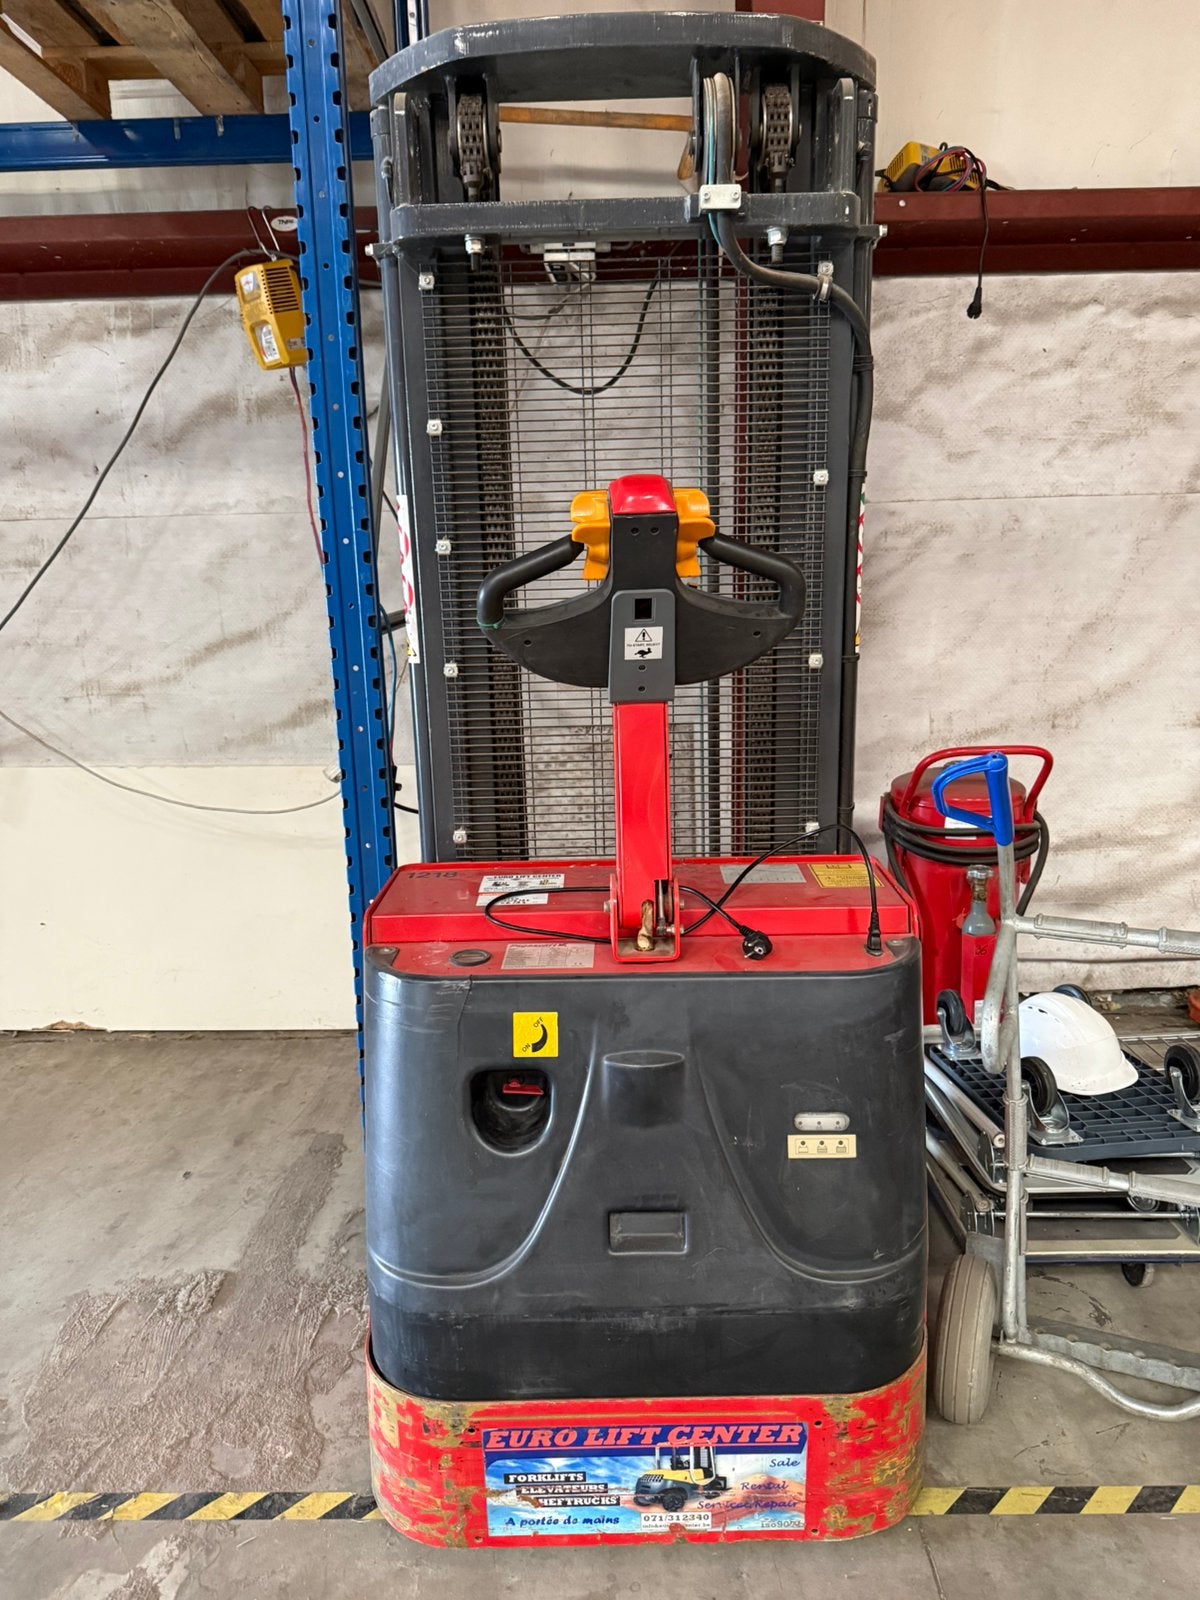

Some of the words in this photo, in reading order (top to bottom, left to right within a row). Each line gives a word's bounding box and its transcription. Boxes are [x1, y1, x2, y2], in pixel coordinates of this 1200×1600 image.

[533, 1016, 544, 1028] OFF
[521, 1043, 531, 1052] ON
[485, 1428, 578, 1448] EURO
[583, 1427, 662, 1446] LIFT
[667, 1424, 803, 1444] CENTER
[768, 1457, 801, 1468] Sale
[508, 1473, 584, 1483] FORKLIFTS
[740, 1480, 789, 1491] Rental
[505, 1517, 516, 1526] A
[520, 1515, 559, 1528] portée
[563, 1515, 579, 1525] de
[582, 1514, 620, 1525] mains
[643, 1513, 710, 1522] 071/312340
